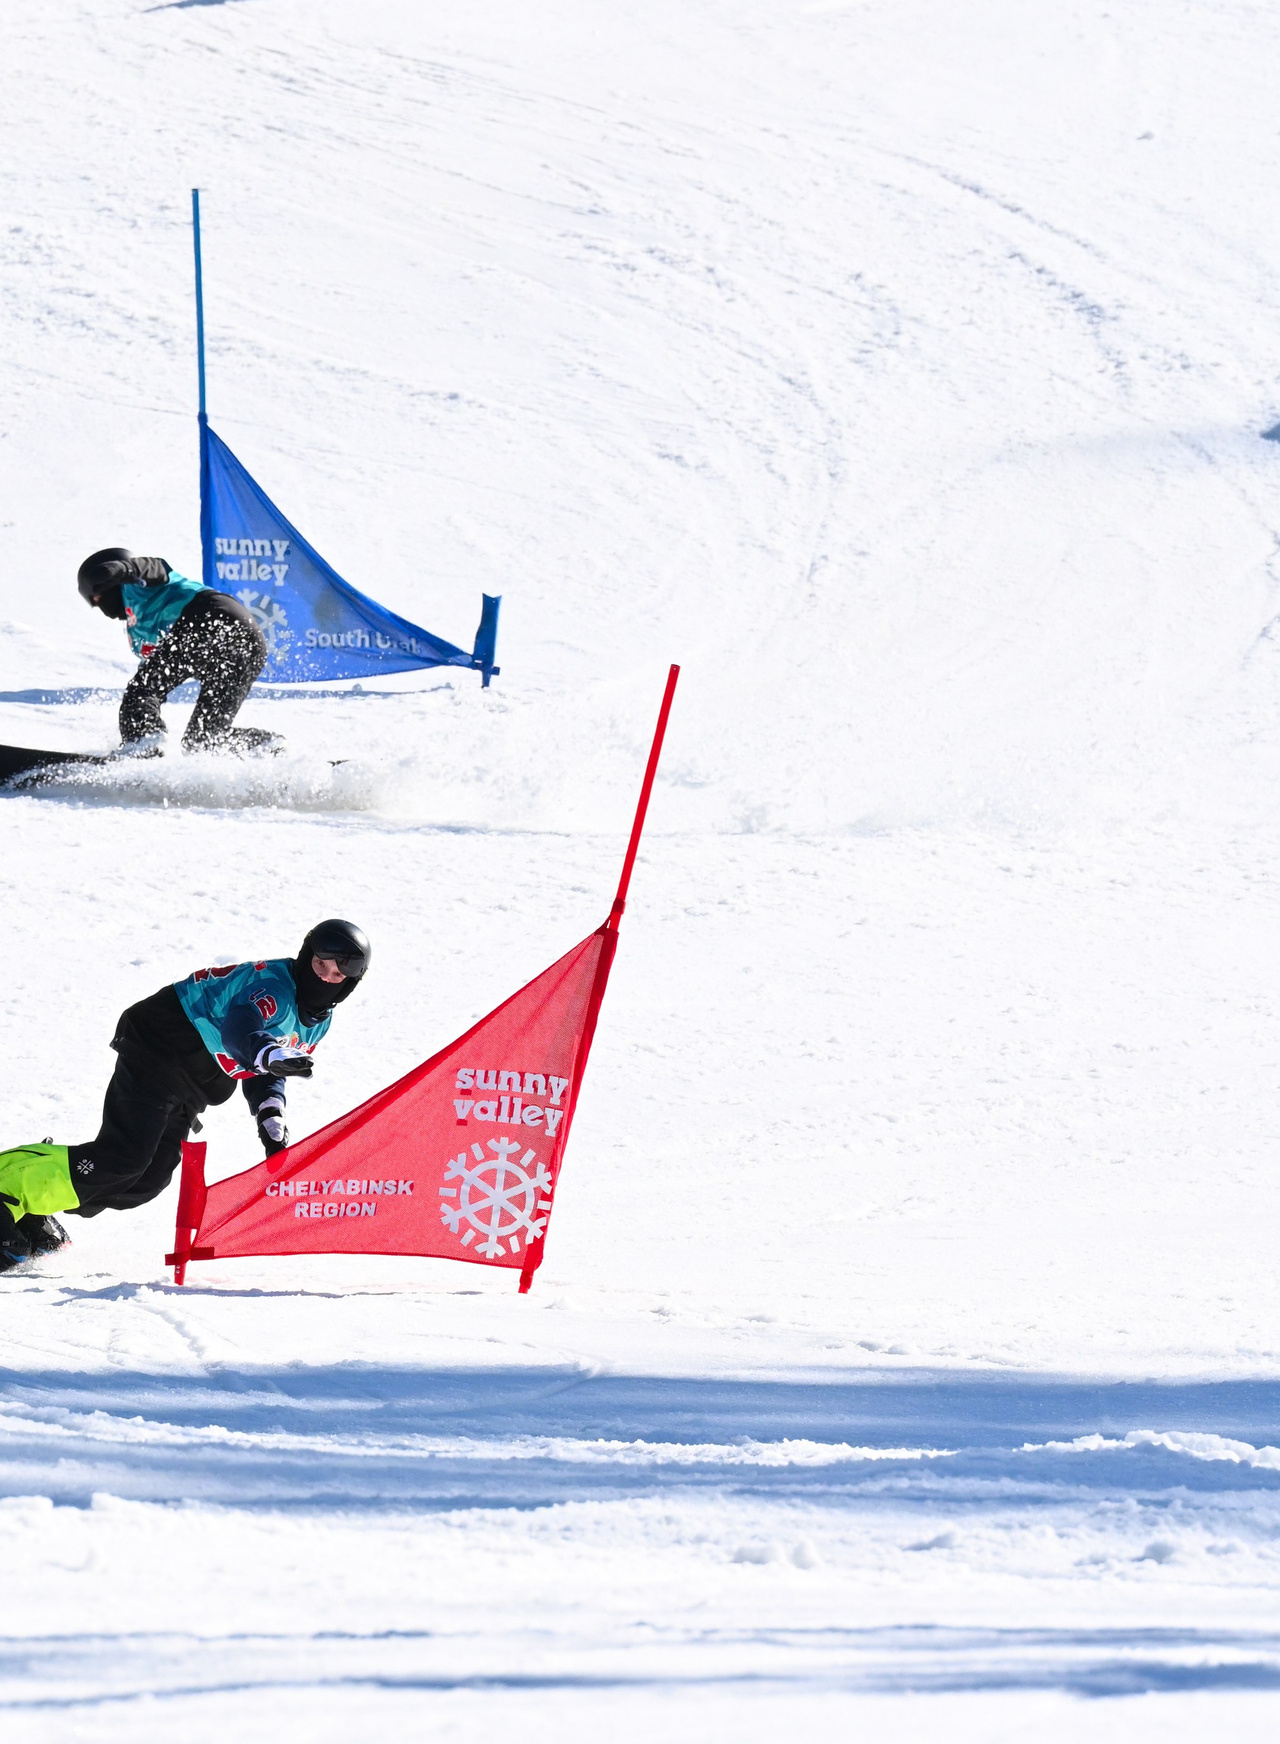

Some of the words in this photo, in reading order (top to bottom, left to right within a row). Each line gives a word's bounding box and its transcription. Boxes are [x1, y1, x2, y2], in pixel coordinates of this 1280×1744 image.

[215, 537, 290, 562] sunny
[216, 559, 289, 587] valley
[305, 628, 371, 648] South
[376, 631, 420, 654] Ual
[455, 1067, 568, 1105] sunny
[453, 1096, 563, 1137] valley
[265, 1179, 415, 1197] CHELYABINSK
[295, 1202, 376, 1218] REGION
